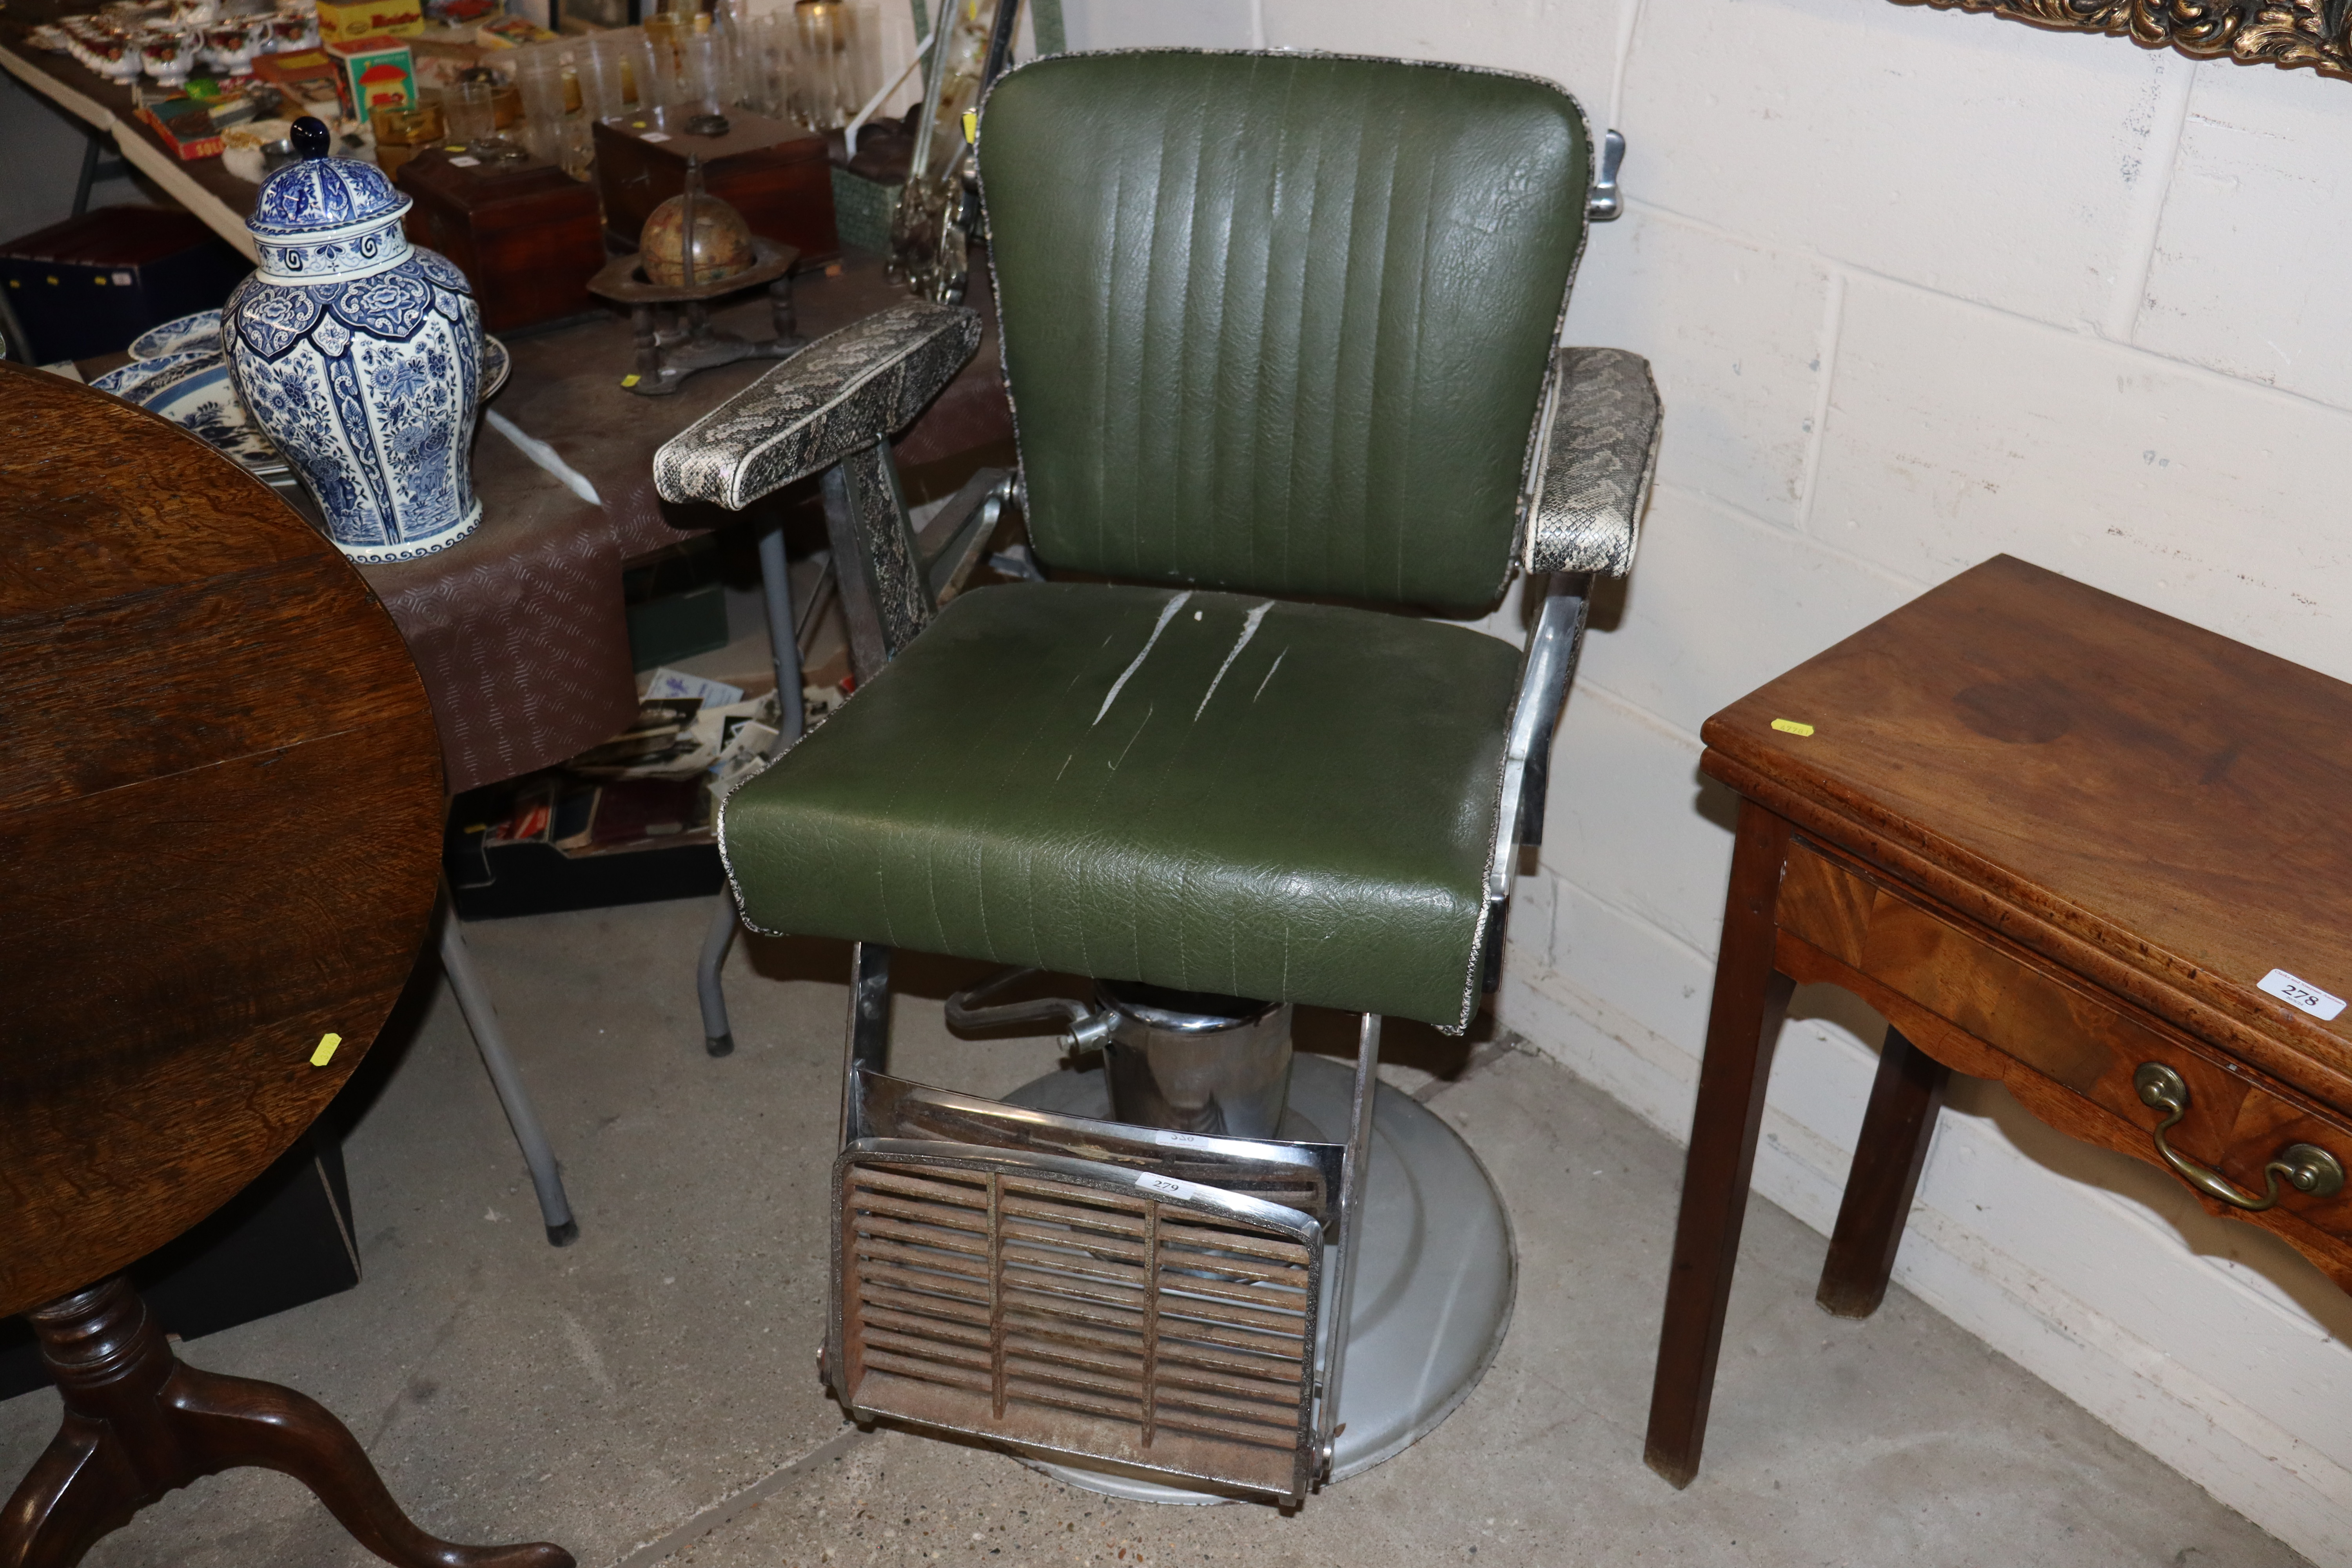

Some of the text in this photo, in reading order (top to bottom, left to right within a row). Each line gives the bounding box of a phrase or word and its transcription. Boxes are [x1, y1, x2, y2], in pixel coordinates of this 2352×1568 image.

[2275, 970, 2290, 979] Clarke
[2301, 983, 2322, 995] Simpson
[2281, 985, 2319, 1006] 278
[1153, 1180, 1179, 1191] 279
